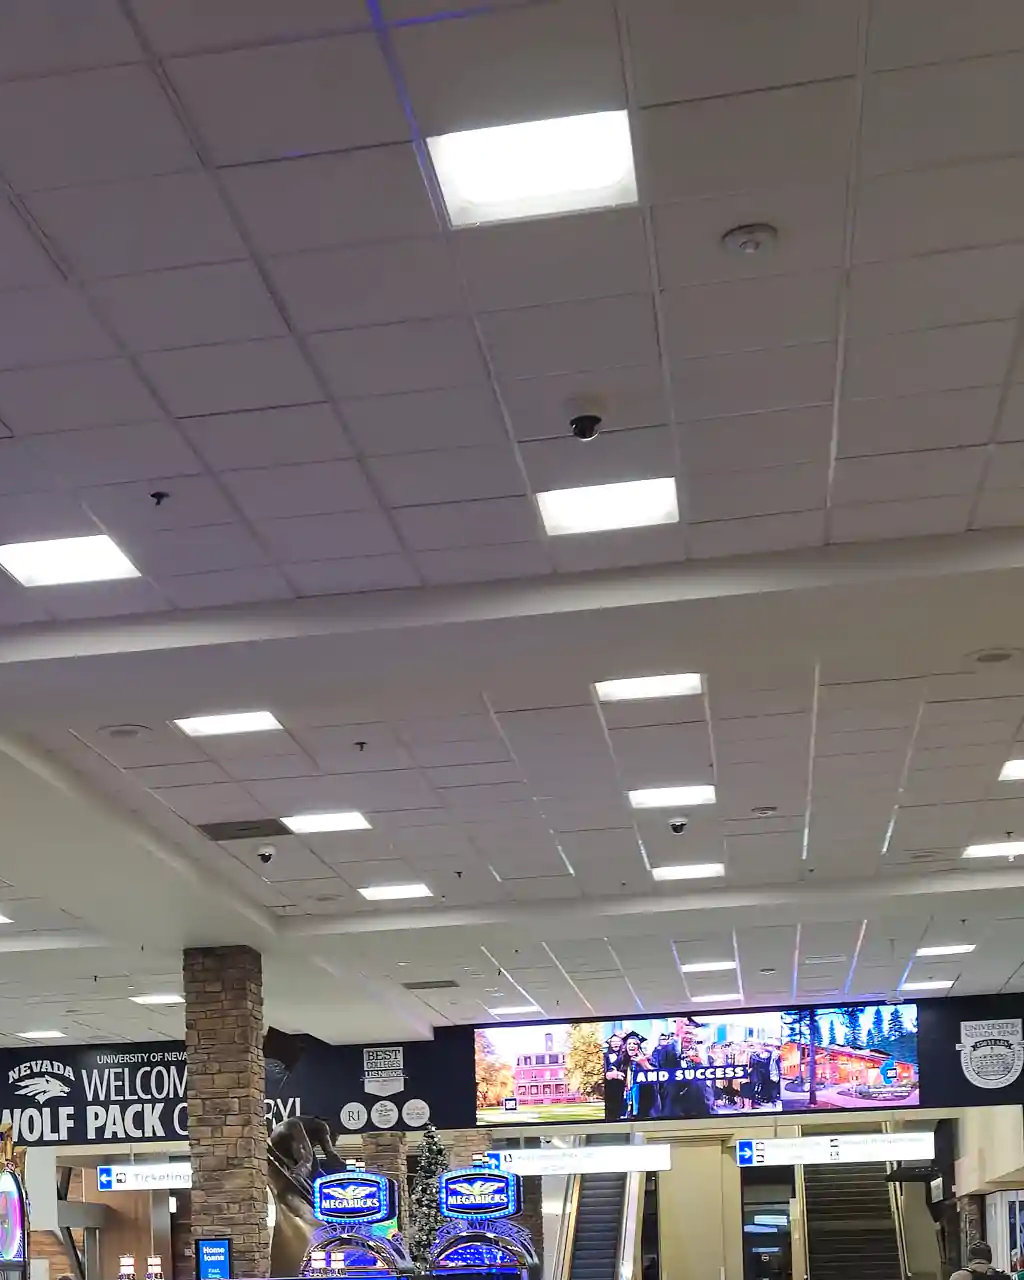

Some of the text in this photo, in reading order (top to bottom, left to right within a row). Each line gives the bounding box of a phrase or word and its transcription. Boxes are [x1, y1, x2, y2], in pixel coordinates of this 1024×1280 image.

[97, 1053, 148, 1064] UNIVERSITY
[150, 1053, 163, 1062] OF
[367, 1050, 400, 1061] BEST
[8, 1060, 76, 1083] NEVADA
[636, 1067, 744, 1082] AND SUCCESS
[86, 1103, 166, 1139] PACK
[134, 1171, 190, 1185] Ticketing
[321, 1199, 380, 1209] MEGABUCKS
[448, 1194, 508, 1205] MEGABUCKS
[203, 1246, 225, 1254] Home
